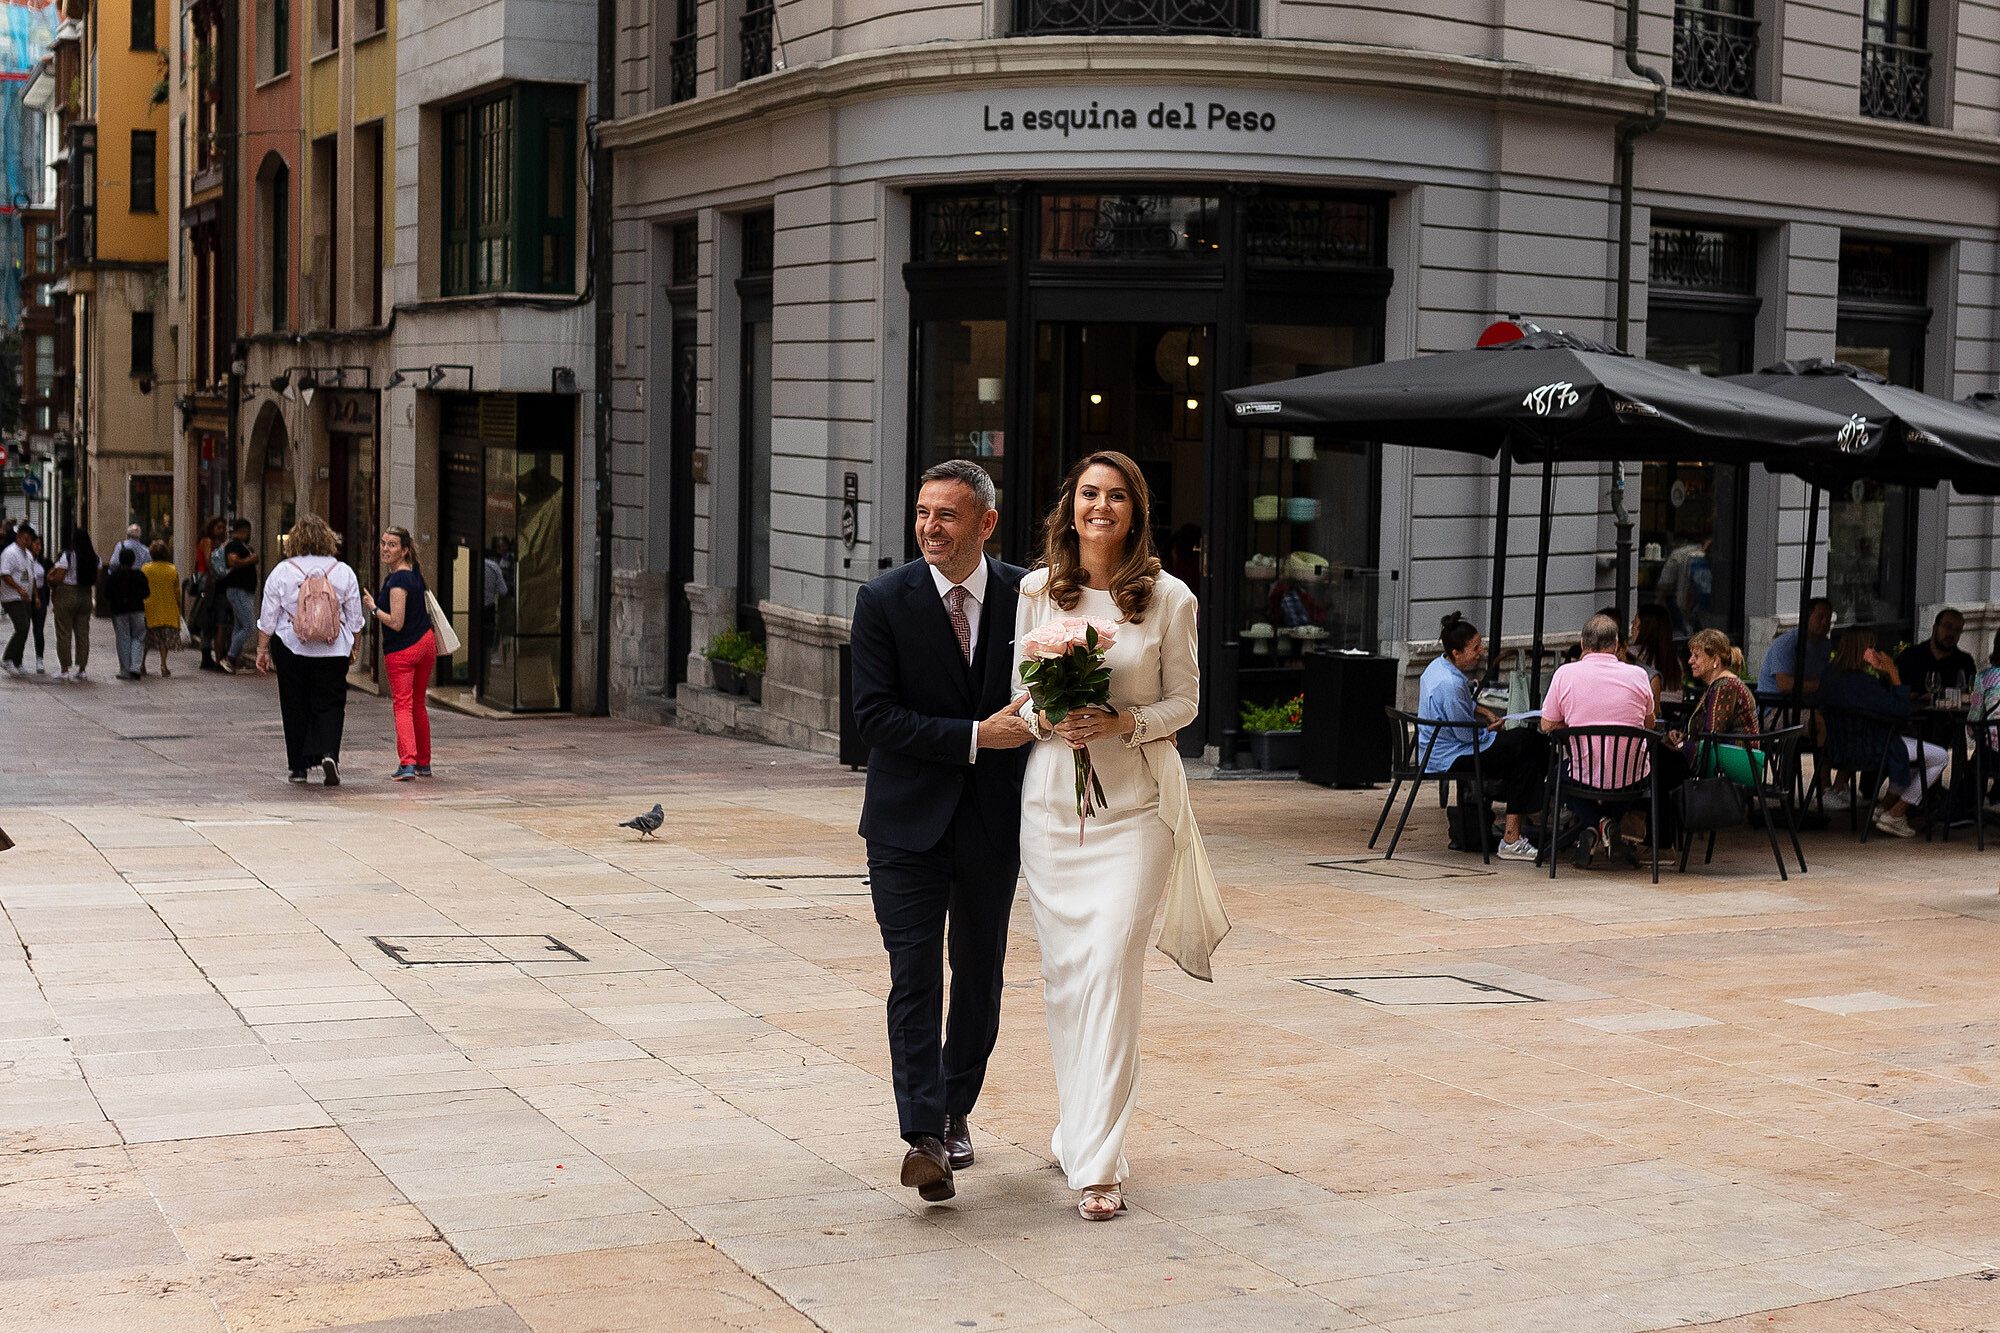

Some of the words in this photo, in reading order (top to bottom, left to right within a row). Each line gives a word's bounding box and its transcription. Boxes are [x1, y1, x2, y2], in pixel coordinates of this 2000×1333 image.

[983, 105, 1014, 131] La
[1022, 101, 1137, 137] esquina
[1147, 102, 1197, 130] del
[1207, 103, 1276, 131] Peso
